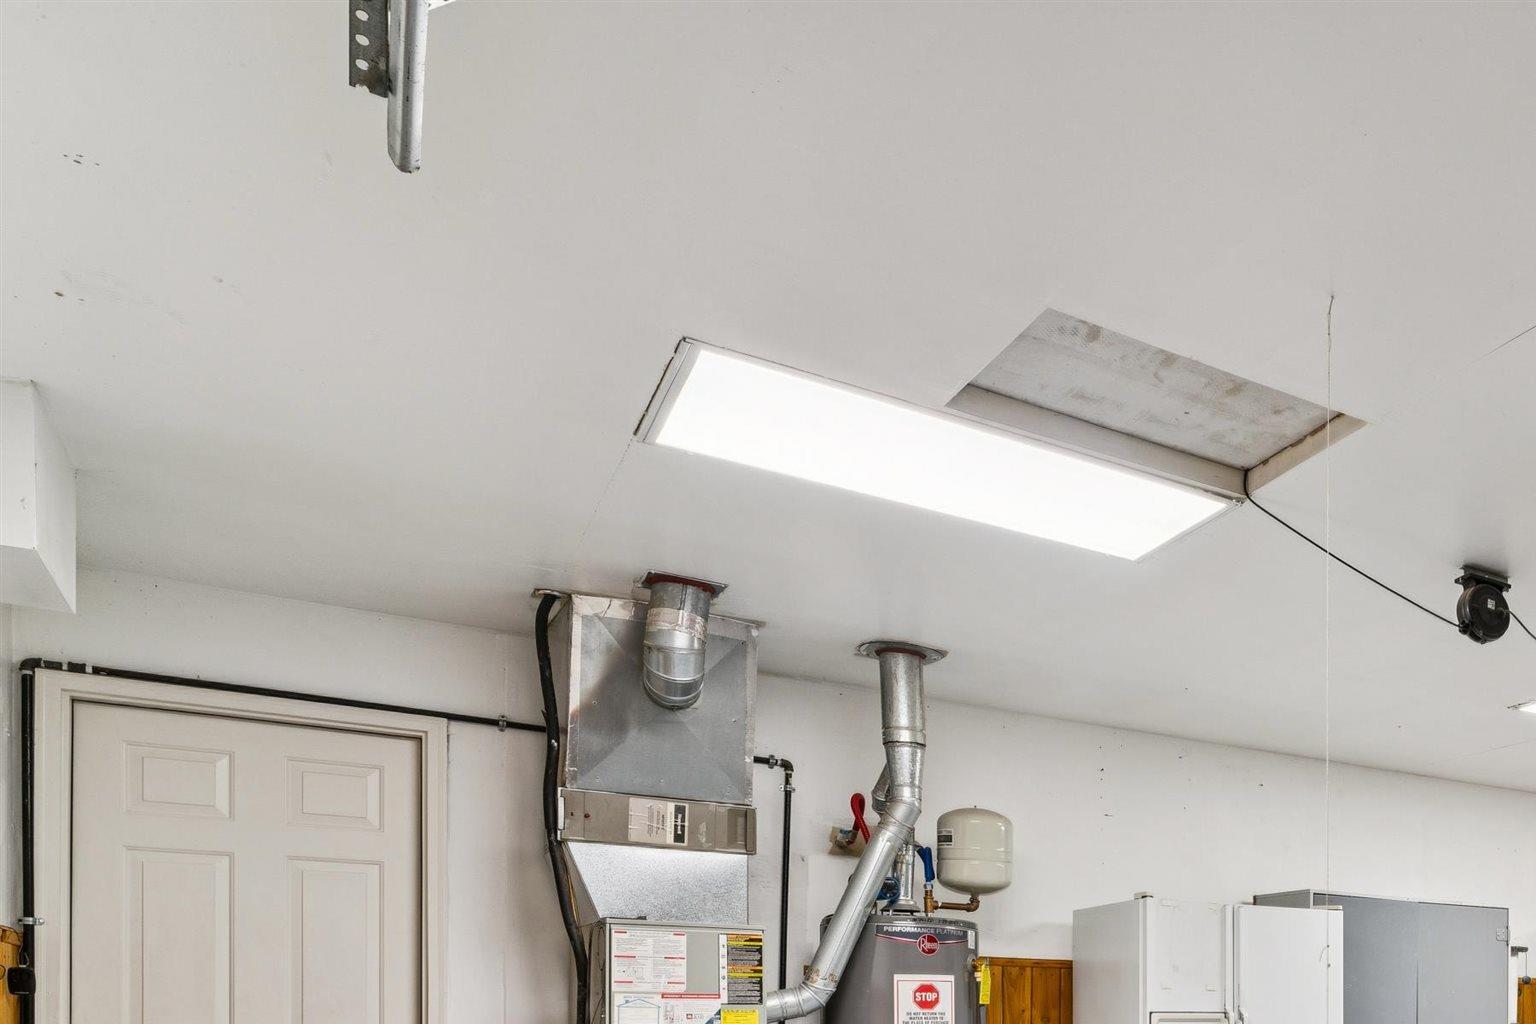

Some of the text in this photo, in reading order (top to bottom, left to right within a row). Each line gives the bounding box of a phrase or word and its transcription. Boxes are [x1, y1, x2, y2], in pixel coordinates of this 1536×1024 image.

[883, 926, 964, 936] PERFORMANCE PLATINUM
[920, 934, 938, 952] Rheem
[915, 992, 938, 1001] STOP
